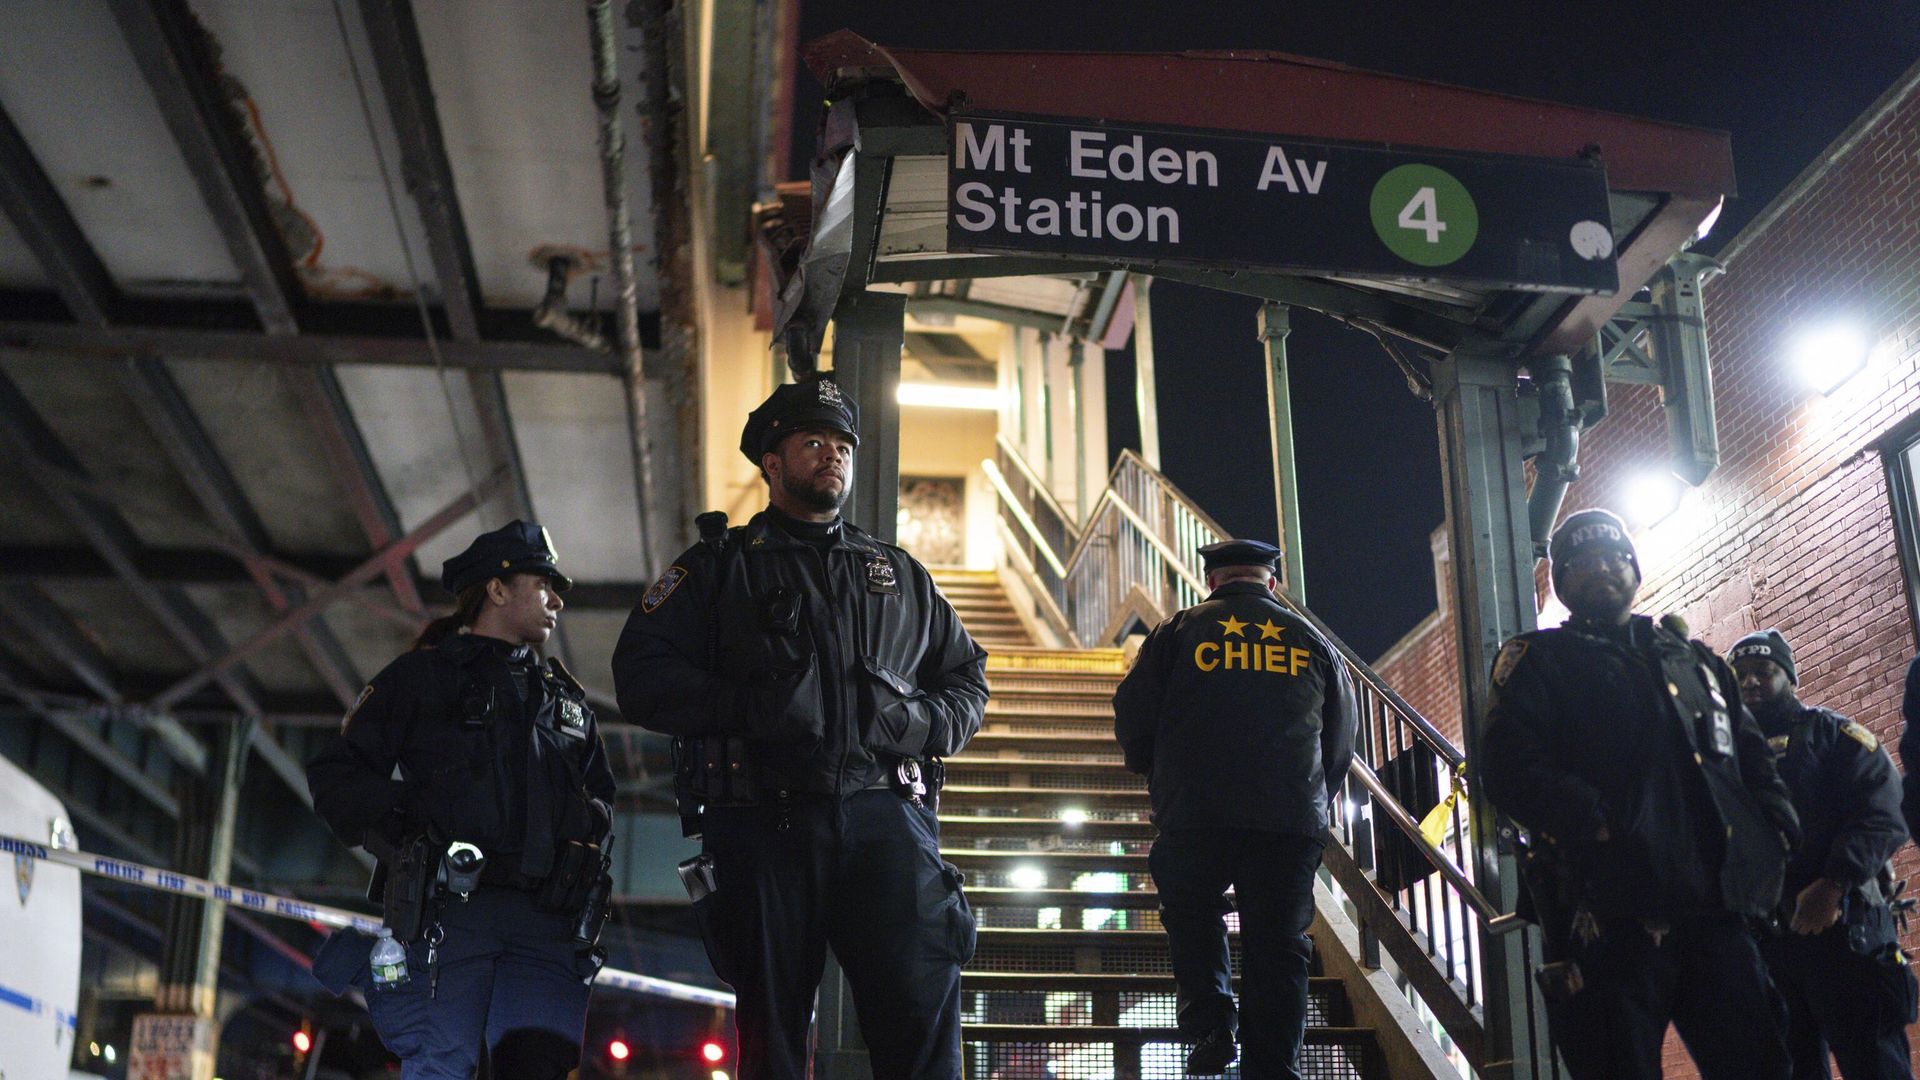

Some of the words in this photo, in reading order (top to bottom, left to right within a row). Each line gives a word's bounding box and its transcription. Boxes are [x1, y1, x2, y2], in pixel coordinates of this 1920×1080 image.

[955, 122, 1032, 174] Mt
[1070, 130, 1218, 187] Eden
[1256, 146, 1328, 195] Av
[954, 181, 1180, 244] Station
[1398, 186, 1447, 243] 4
[1571, 523, 1621, 546] NYPD
[1194, 641, 1310, 677] CHIEF
